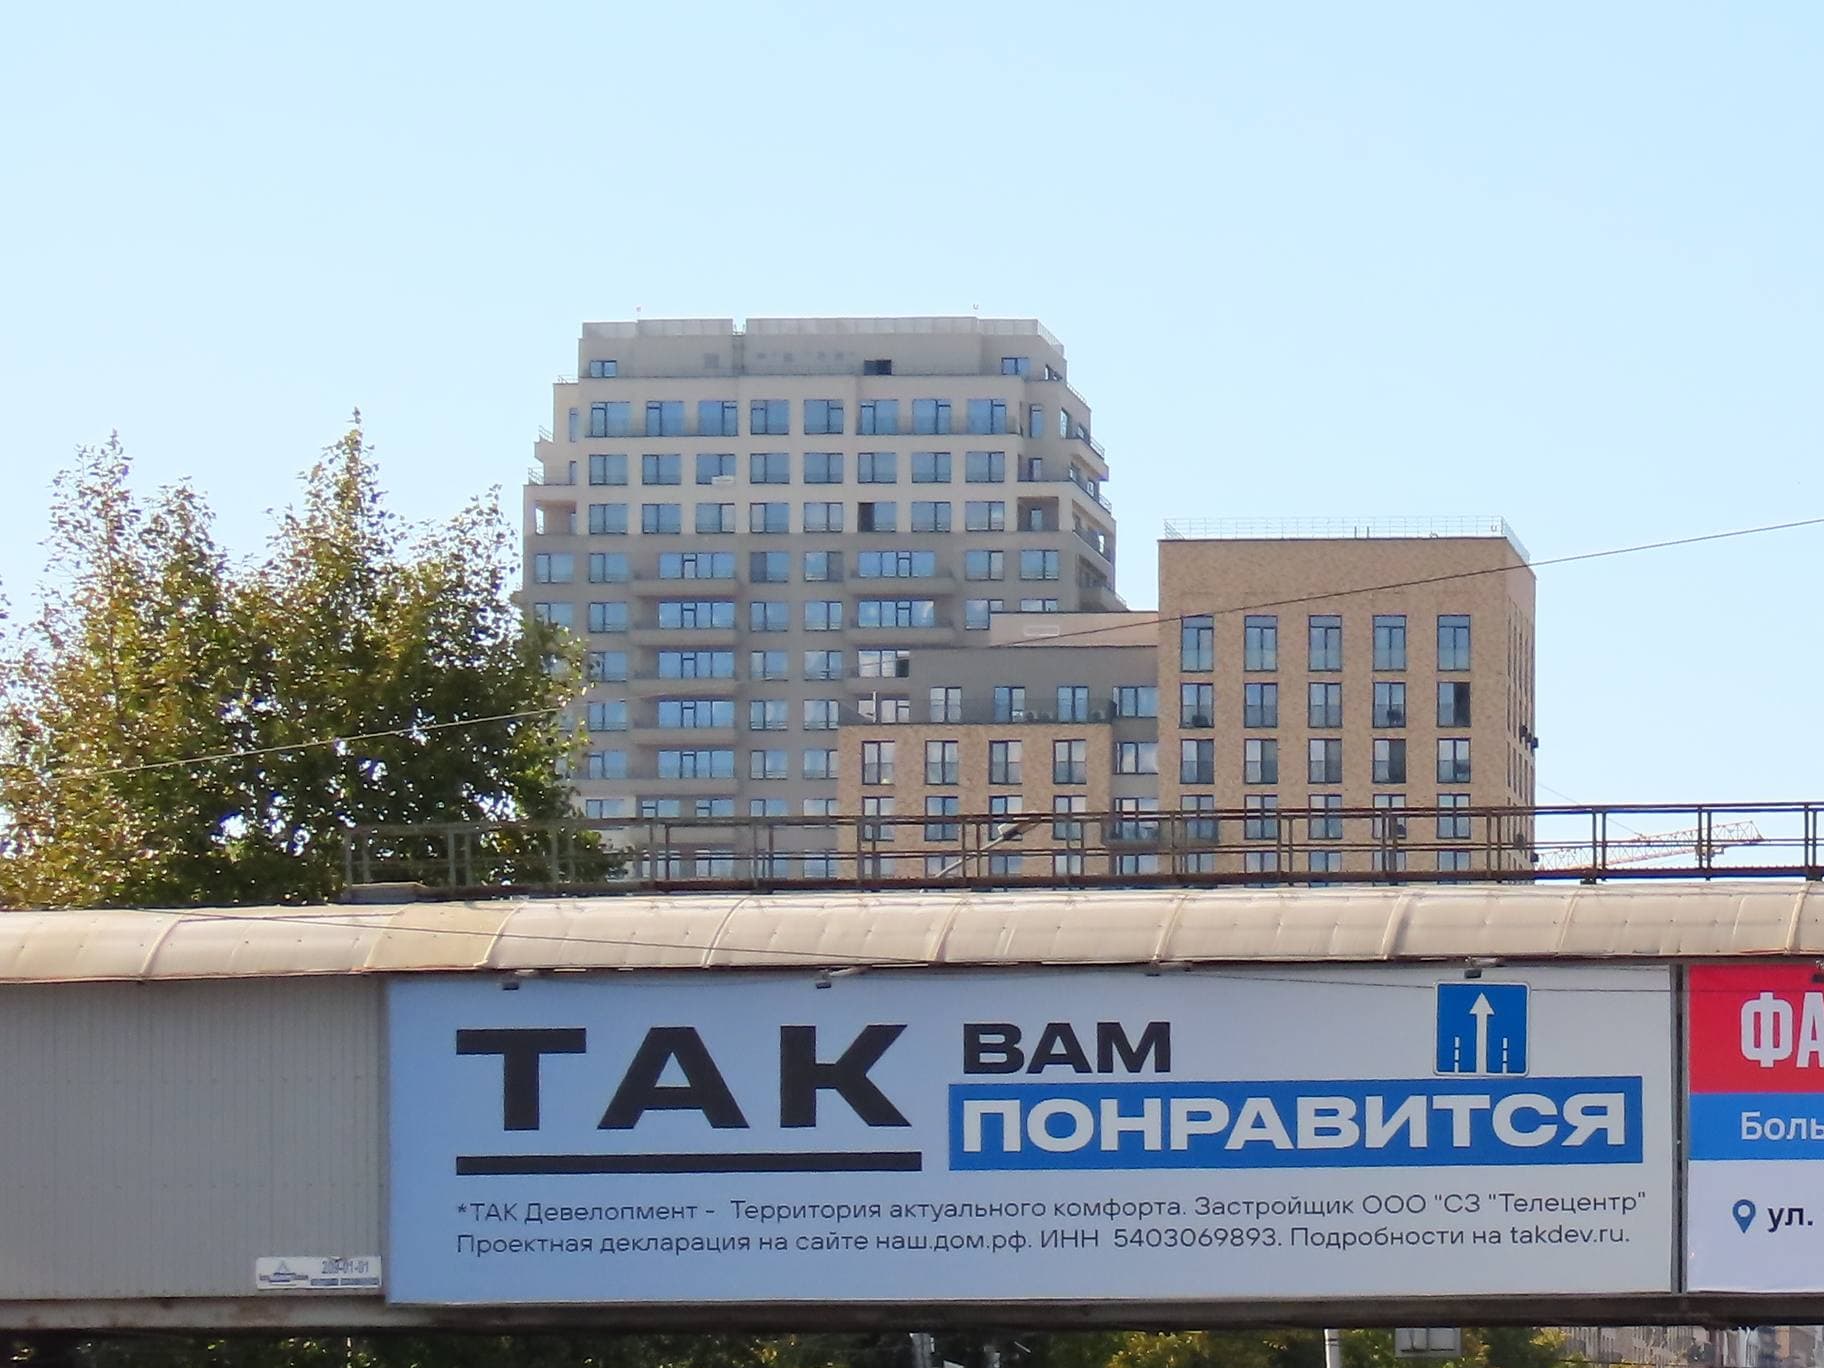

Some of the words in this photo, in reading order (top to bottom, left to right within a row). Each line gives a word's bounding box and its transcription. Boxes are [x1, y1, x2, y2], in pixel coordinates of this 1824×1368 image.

[963, 1021, 1171, 1074] ВАМ
[456, 1024, 911, 1131] ТАК
[963, 1092, 1625, 1153] ПОНРАВИТСЯ
[524, 1203, 697, 1224] Девелопмент
[731, 1200, 881, 1223] Территория
[890, 1202, 1046, 1222] актуального
[1054, 1198, 1186, 1220] комфорта.
[1195, 1196, 1354, 1219] Застройщик
[1362, 1194, 1426, 1215] ООО
[1488, 1192, 1646, 1218] "Телецентр"
[1767, 1207, 1813, 1232] ул.
[457, 1235, 593, 1257] Проектная
[600, 1236, 750, 1255] декларация
[760, 1236, 787, 1250] на
[796, 1232, 868, 1250] сайте
[877, 1230, 1031, 1253] наш.дом.рф.
[1041, 1229, 1098, 1248] ИНН
[1114, 1228, 1282, 1248] 5403069893.
[1291, 1227, 1464, 1250] Подробности
[1473, 1231, 1501, 1244] на
[1511, 1224, 1630, 1244] takdev.ru.
